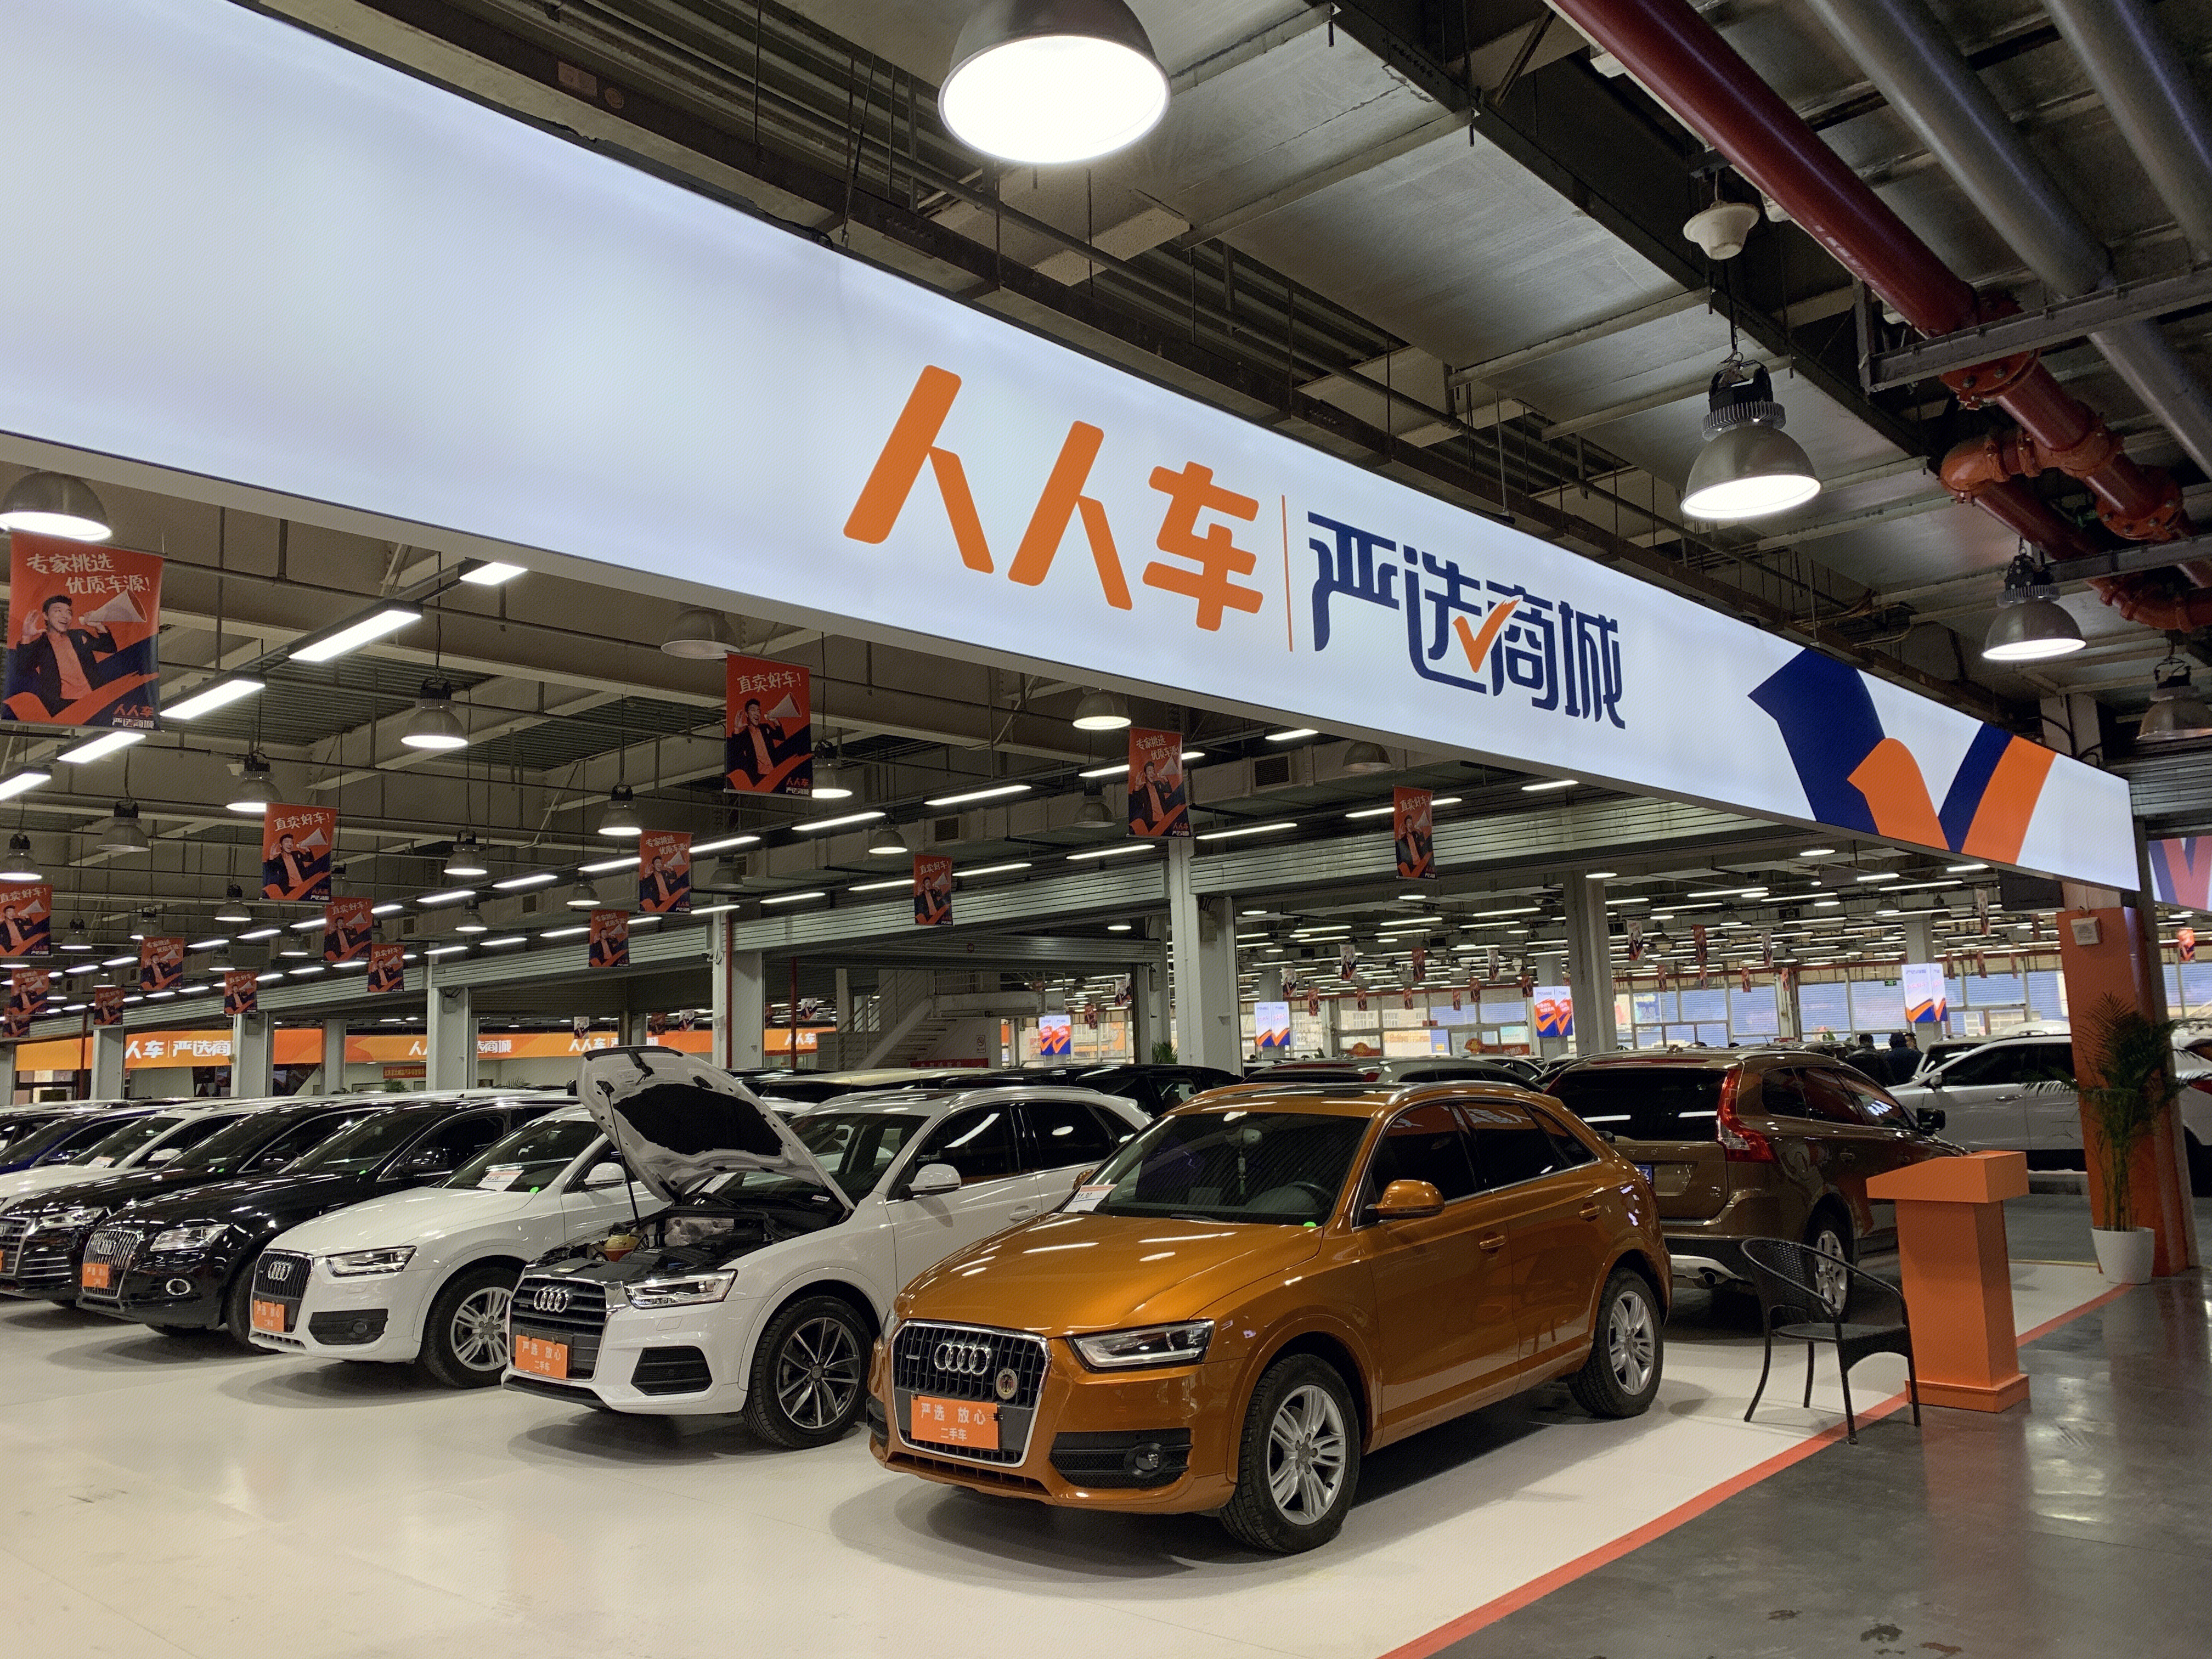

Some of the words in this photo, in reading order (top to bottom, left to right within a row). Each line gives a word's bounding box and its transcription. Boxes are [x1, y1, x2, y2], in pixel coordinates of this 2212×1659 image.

[843, 364, 1263, 631] 人人车
[1307, 511, 1626, 730] 严选商城
[27, 553, 115, 574] 专家挑选
[737, 671, 801, 694] 直卖好车!
[113, 704, 154, 716] 人人车
[1136, 734, 1167, 750] 专家挑选
[274, 811, 330, 832] 直卖好车!
[173, 1040, 232, 1057] 严选商
[921, 1402, 945, 1421] 严选
[957, 1407, 986, 1425] 放心
[940, 1427, 967, 1441] 二手车
